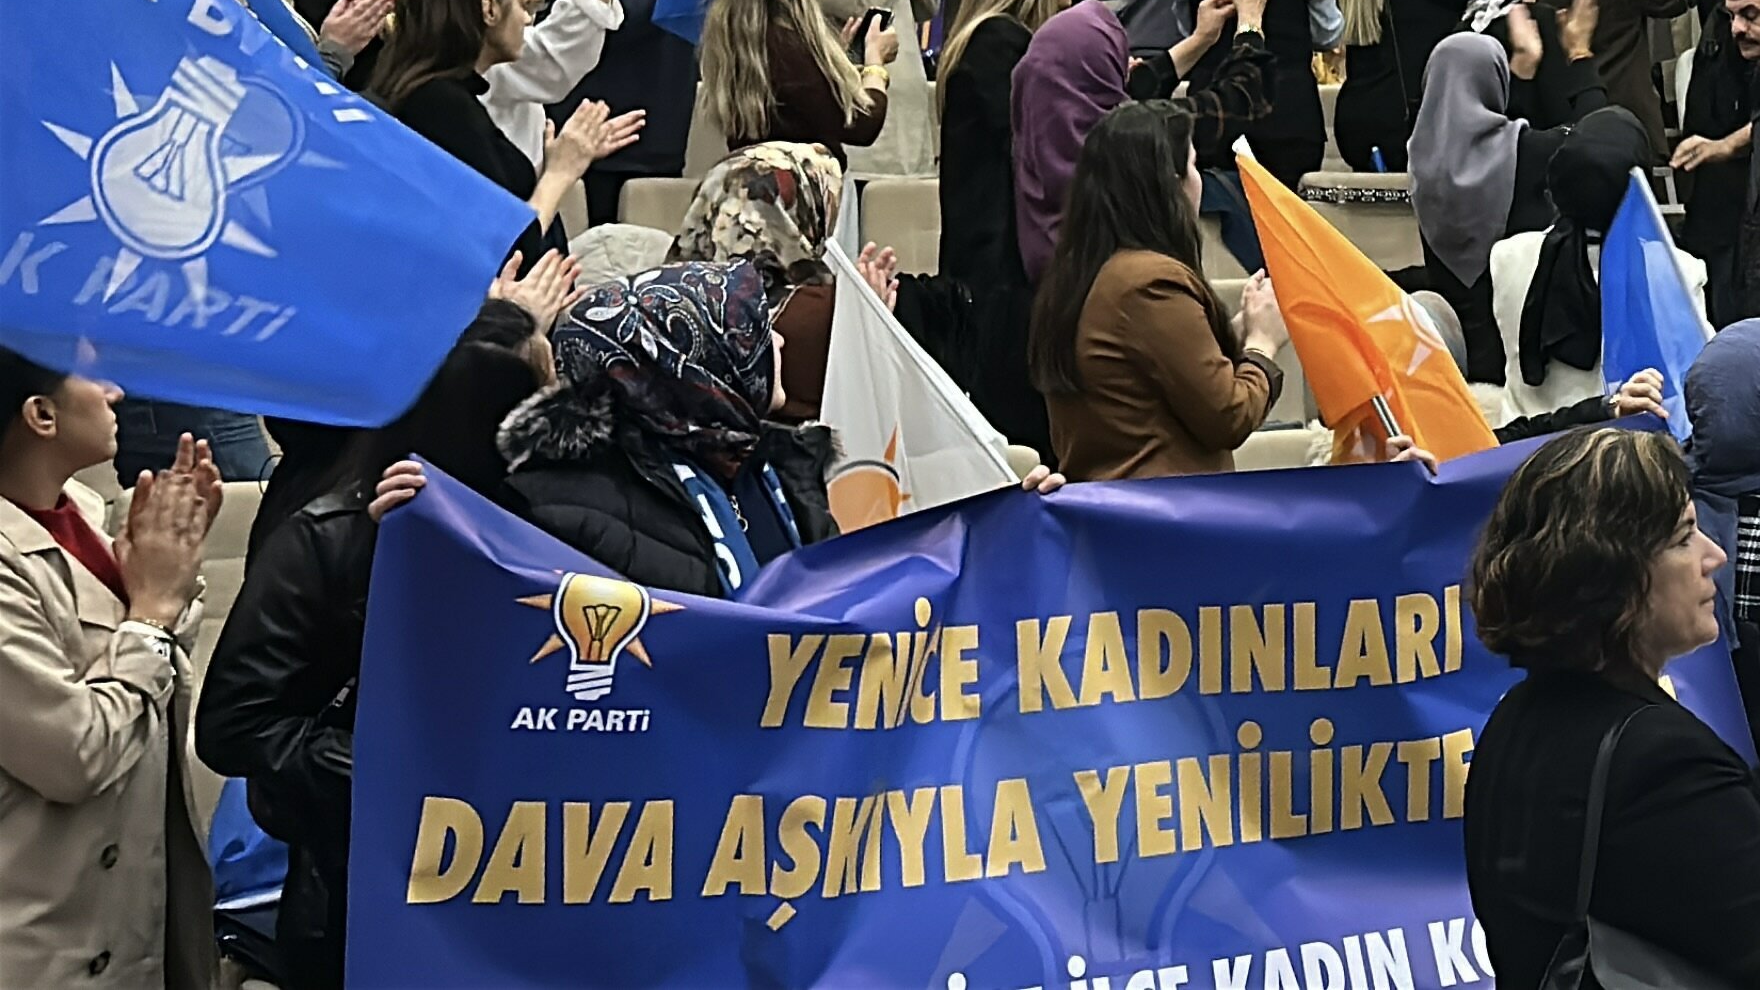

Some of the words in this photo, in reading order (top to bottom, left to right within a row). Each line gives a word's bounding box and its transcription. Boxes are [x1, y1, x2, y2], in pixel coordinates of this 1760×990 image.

[1015, 583, 1464, 714] KADINLARI
[510, 706, 558, 732] AK
[406, 795, 675, 905] DAVA
